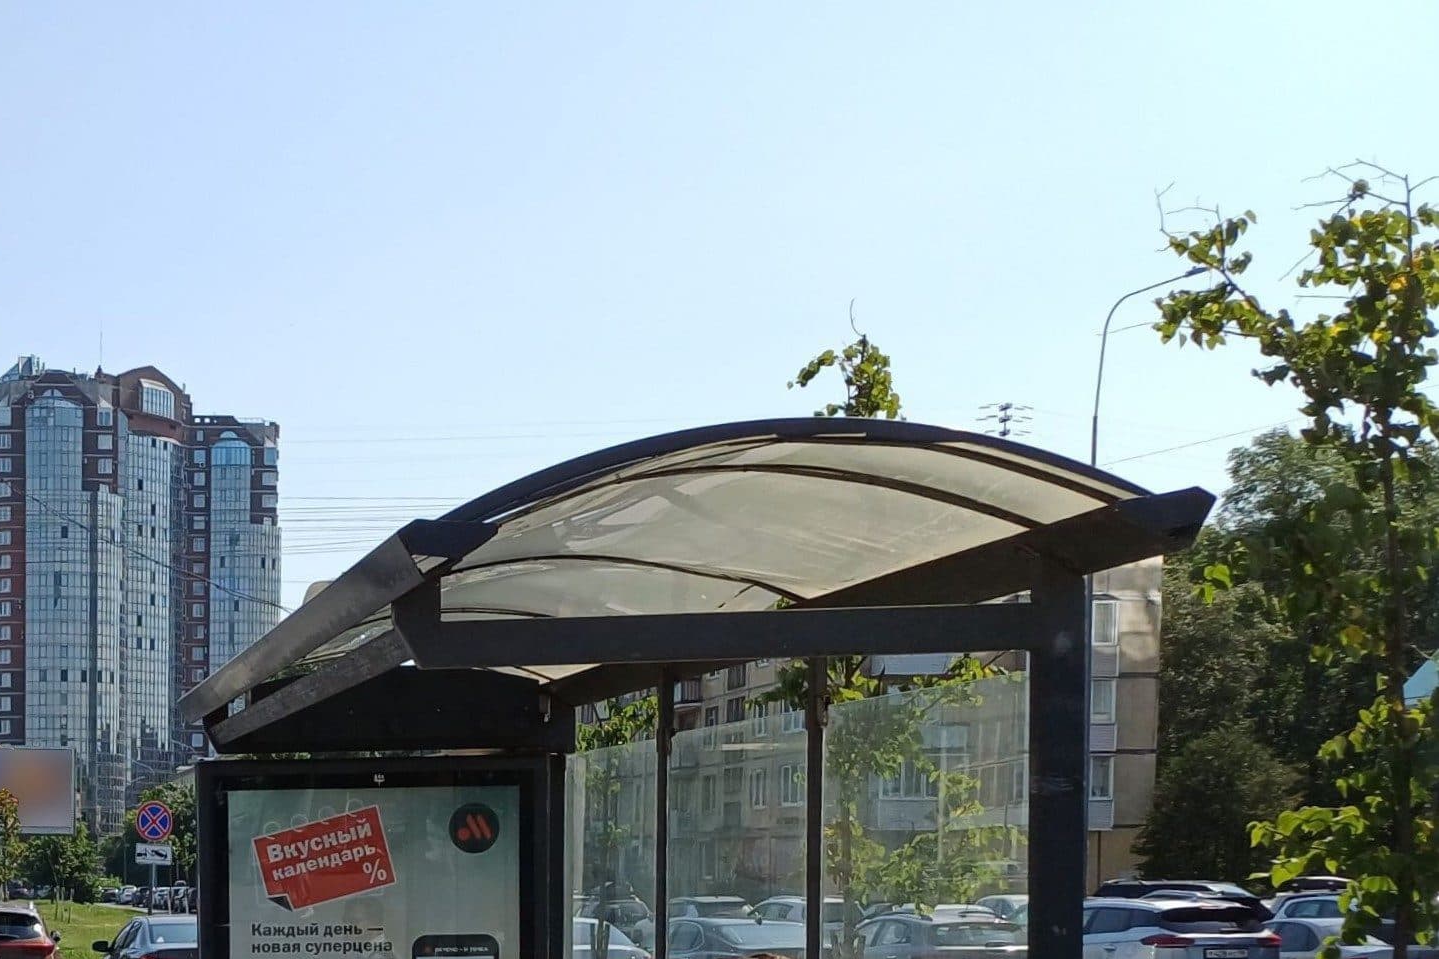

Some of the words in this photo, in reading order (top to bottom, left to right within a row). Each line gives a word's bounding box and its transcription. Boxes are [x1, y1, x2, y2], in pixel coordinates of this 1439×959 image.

[266, 818, 373, 863] Вкусный
[272, 844, 376, 881] календарь
[362, 859, 387, 884] %
[251, 923, 319, 937] Каждый
[323, 924, 363, 937] день
[251, 942, 301, 953] новая
[305, 940, 393, 955] суперцена
